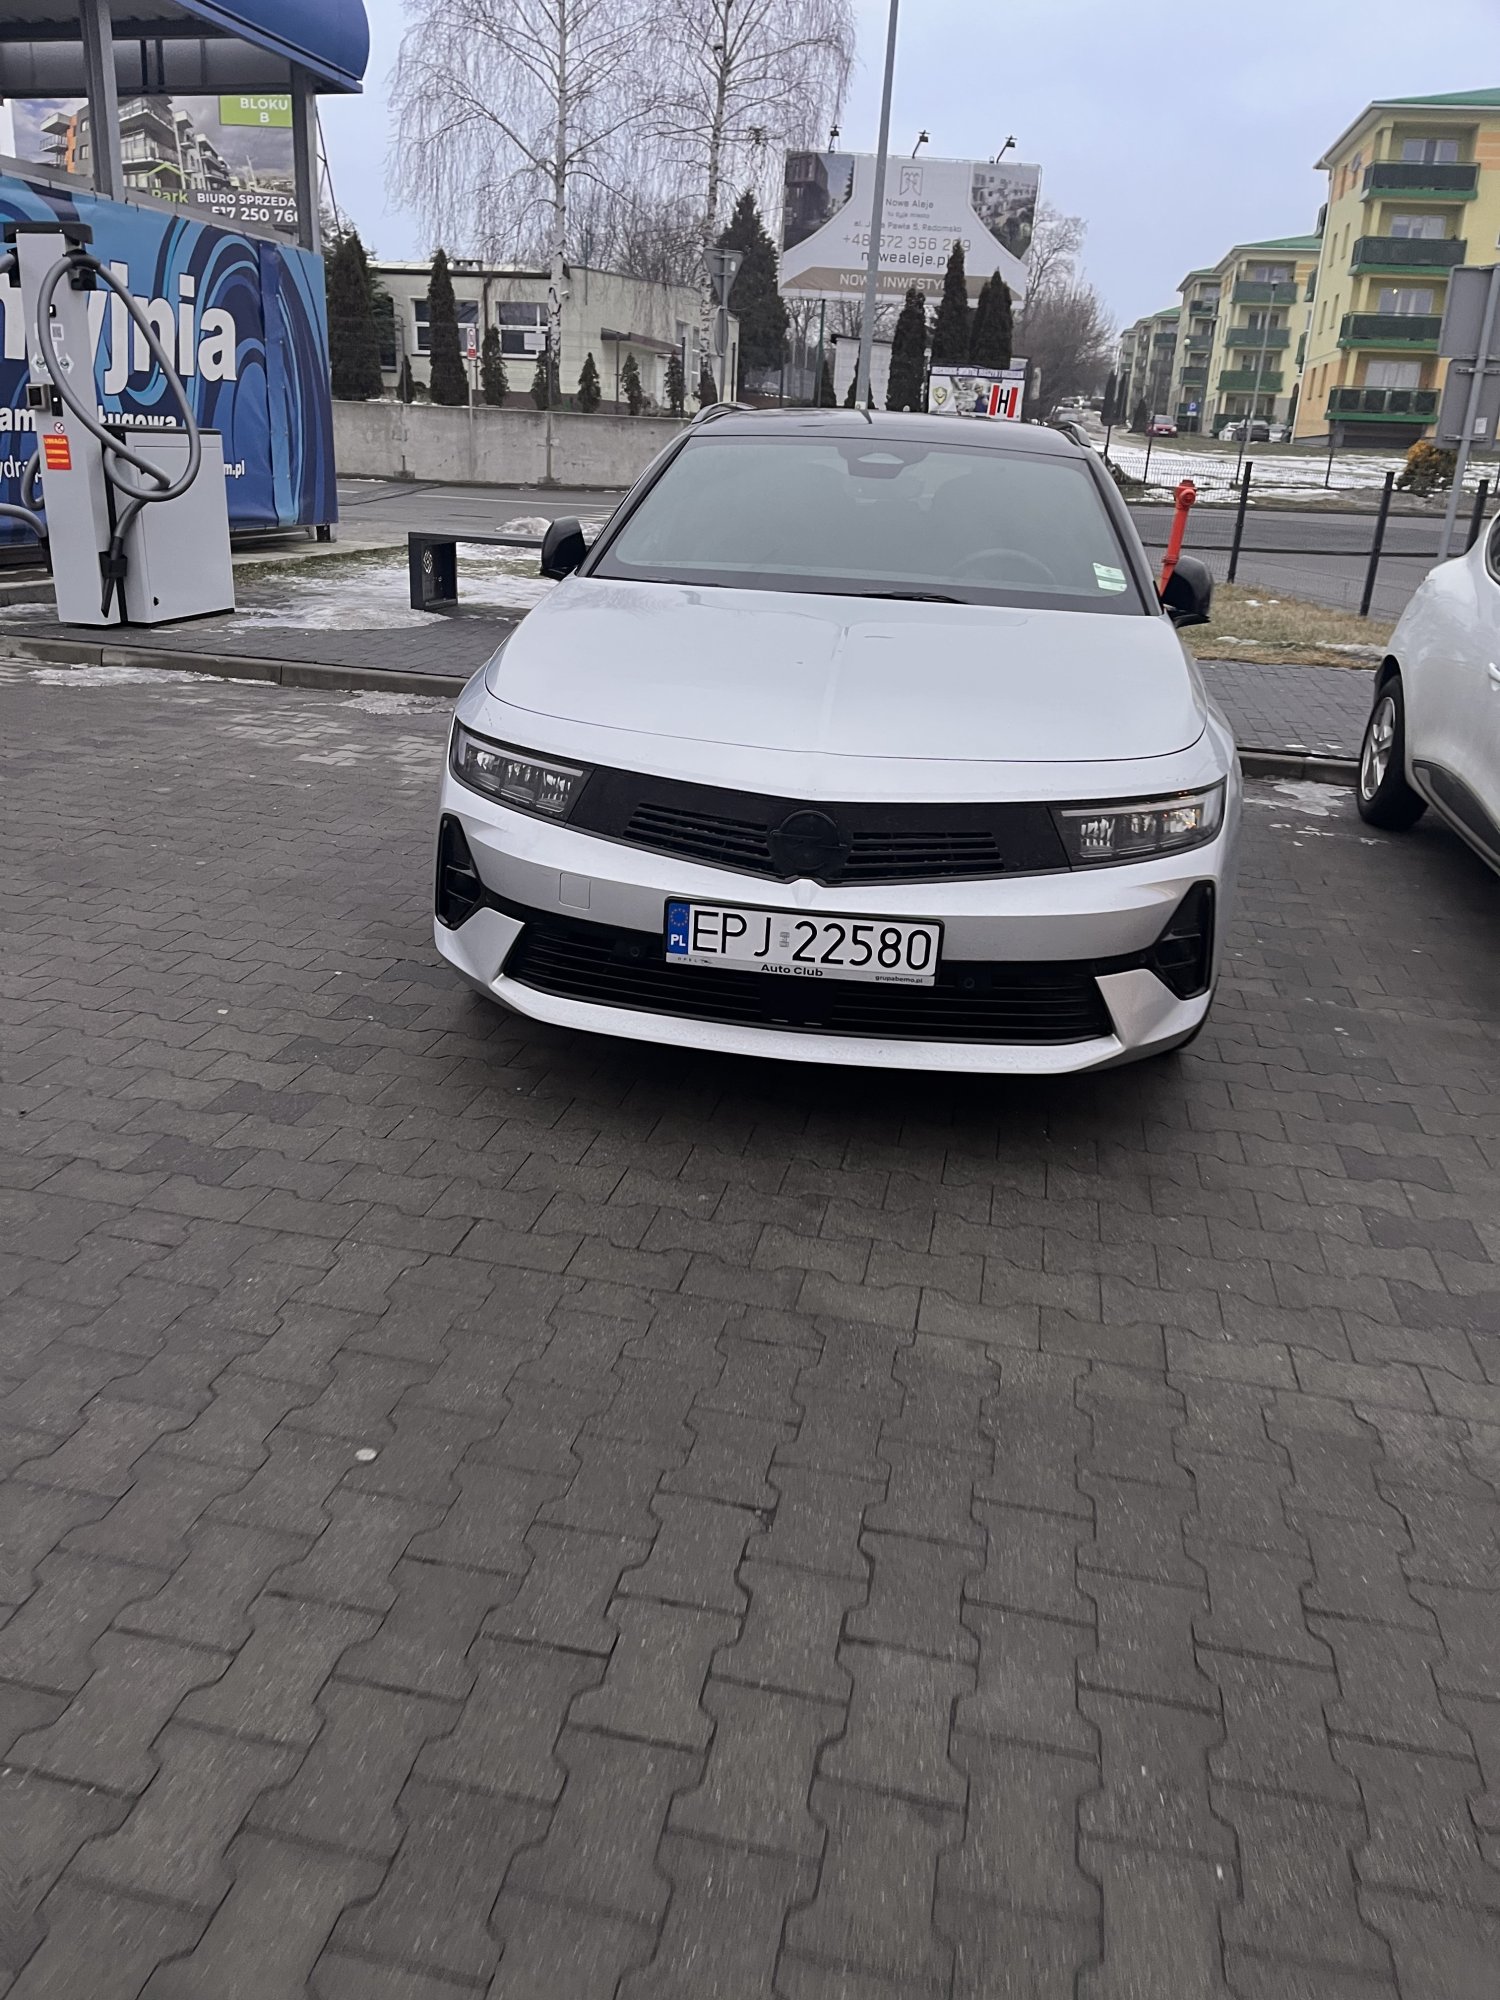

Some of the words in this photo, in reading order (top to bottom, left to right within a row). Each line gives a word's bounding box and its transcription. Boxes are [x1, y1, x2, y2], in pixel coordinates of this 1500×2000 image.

[240, 97, 288, 110] BLOKU
[260, 111, 270, 123] B
[151, 189, 189, 204] Park
[197, 192, 236, 205] BIURO
[239, 194, 297, 208] SPRZEDA
[885, 198, 909, 207] Nowe
[912, 199, 934, 210] Aleje
[240, 207, 270, 222] 250
[843, 233, 870, 248] +48
[908, 236, 937, 251] 356
[861, 251, 951, 269] nwealeje.pl
[840, 273, 879, 288] NOW
[670, 933, 687, 948] PL
[692, 909, 772, 958] EPJ
[792, 920, 932, 971] 22580
[761, 963, 791, 974] Auto
[793, 966, 823, 977] Club
